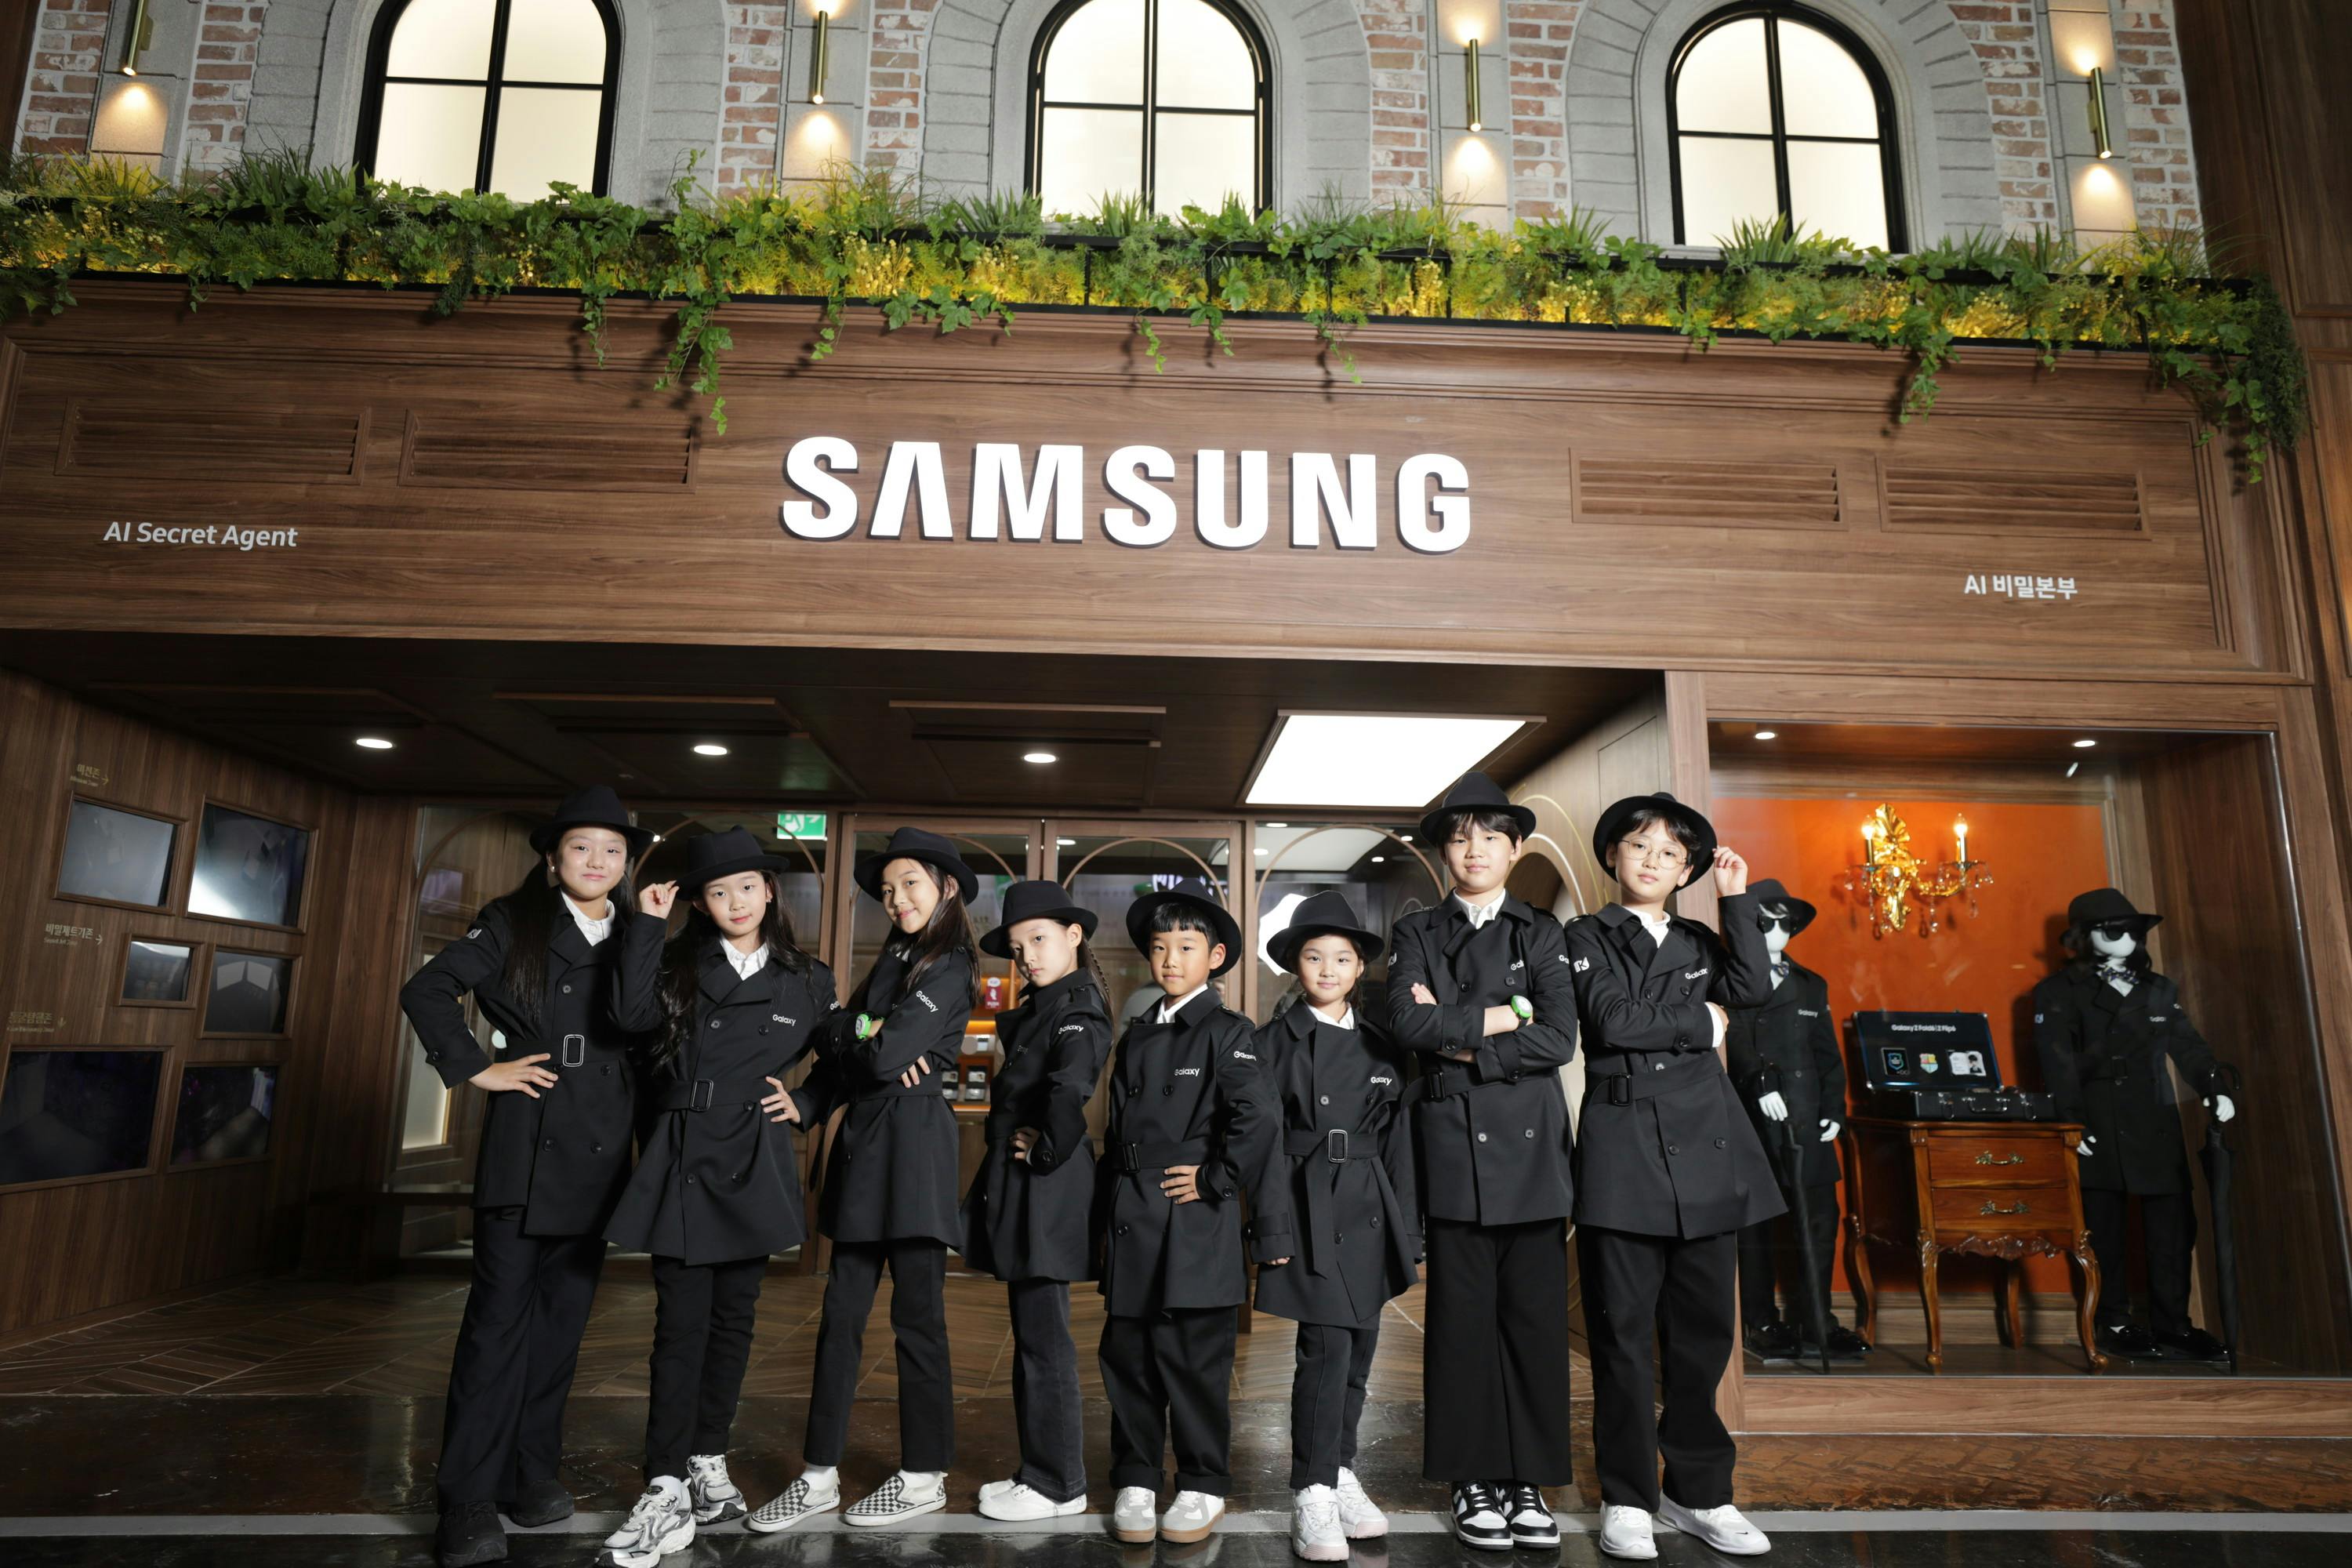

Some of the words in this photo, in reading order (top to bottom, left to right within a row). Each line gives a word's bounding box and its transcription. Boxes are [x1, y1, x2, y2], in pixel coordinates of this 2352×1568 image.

[782, 436, 1472, 554] SAMSUNG
[103, 521, 131, 543] AI
[136, 522, 218, 545] Secret
[221, 525, 299, 551] Agent
[1964, 575, 1987, 595] AI
[1993, 575, 2078, 600] 비밀본부
[916, 990, 938, 1013] Galaxy
[772, 1014, 796, 1026] Galaxy
